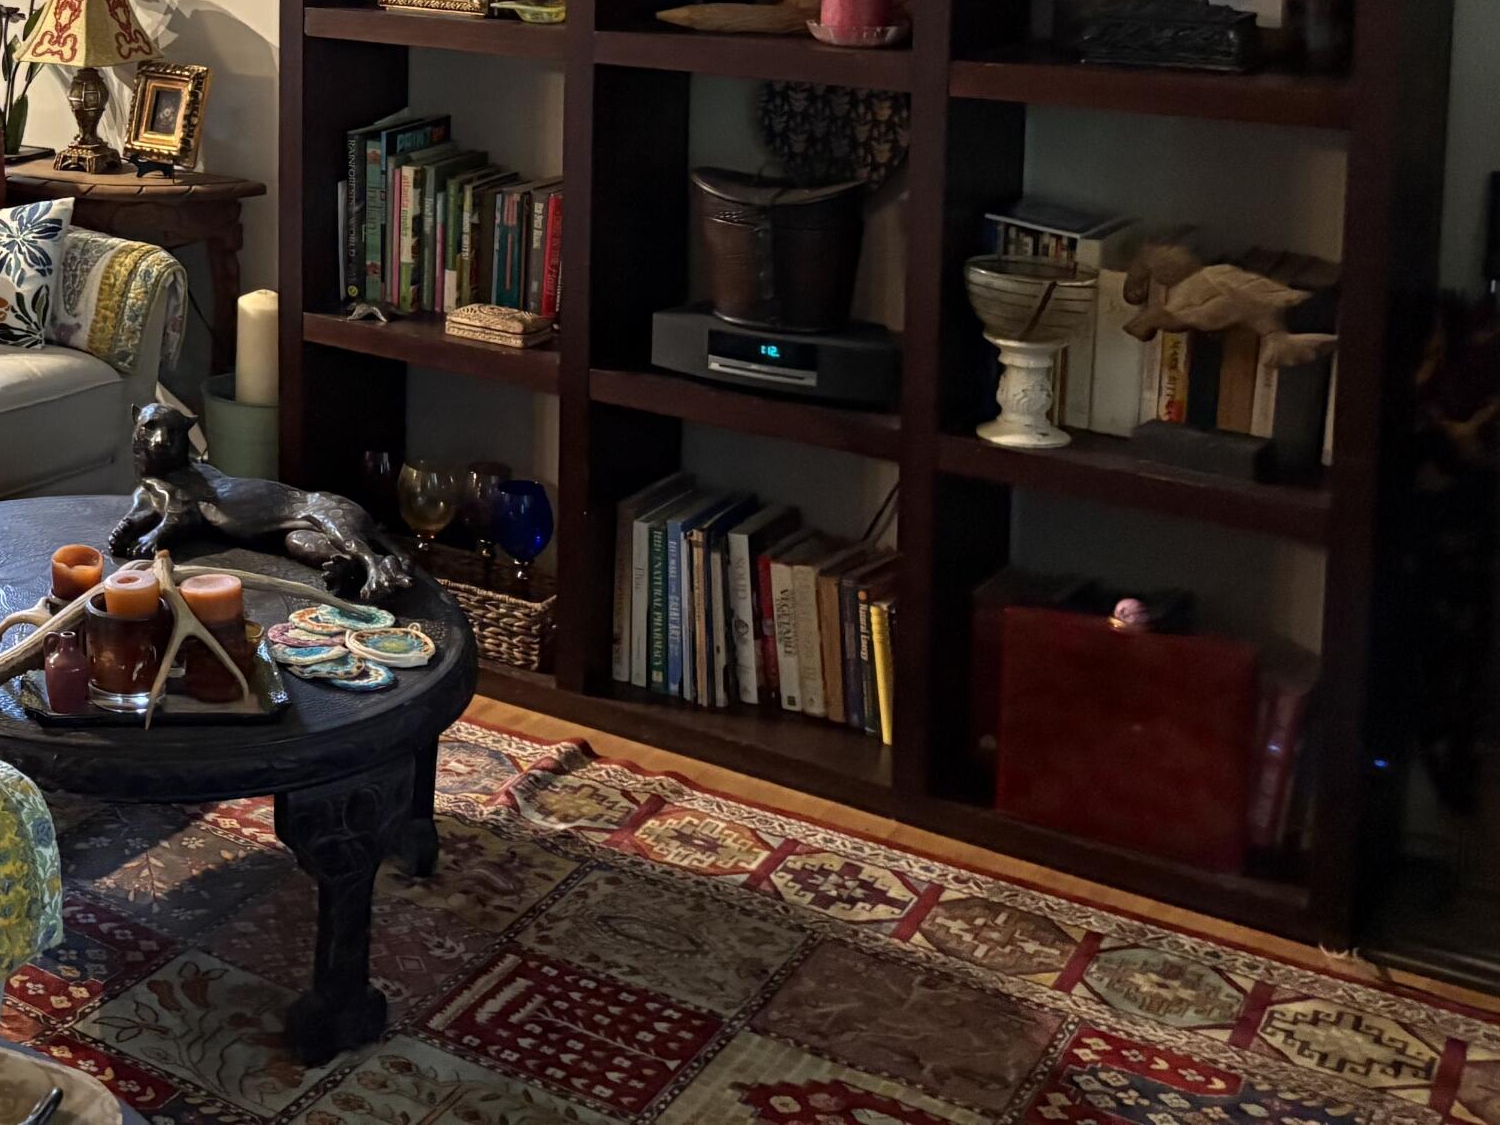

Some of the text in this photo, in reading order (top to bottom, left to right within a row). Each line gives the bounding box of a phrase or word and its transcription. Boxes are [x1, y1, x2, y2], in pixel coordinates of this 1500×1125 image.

[401, 174, 411, 208] atlanta
[652, 560, 663, 609] NATURAL
[652, 610, 663, 667] PHARMACY
[779, 588, 796, 657] VEGETABLE
[858, 603, 868, 633] Natural
[859, 634, 869, 662] Energy
